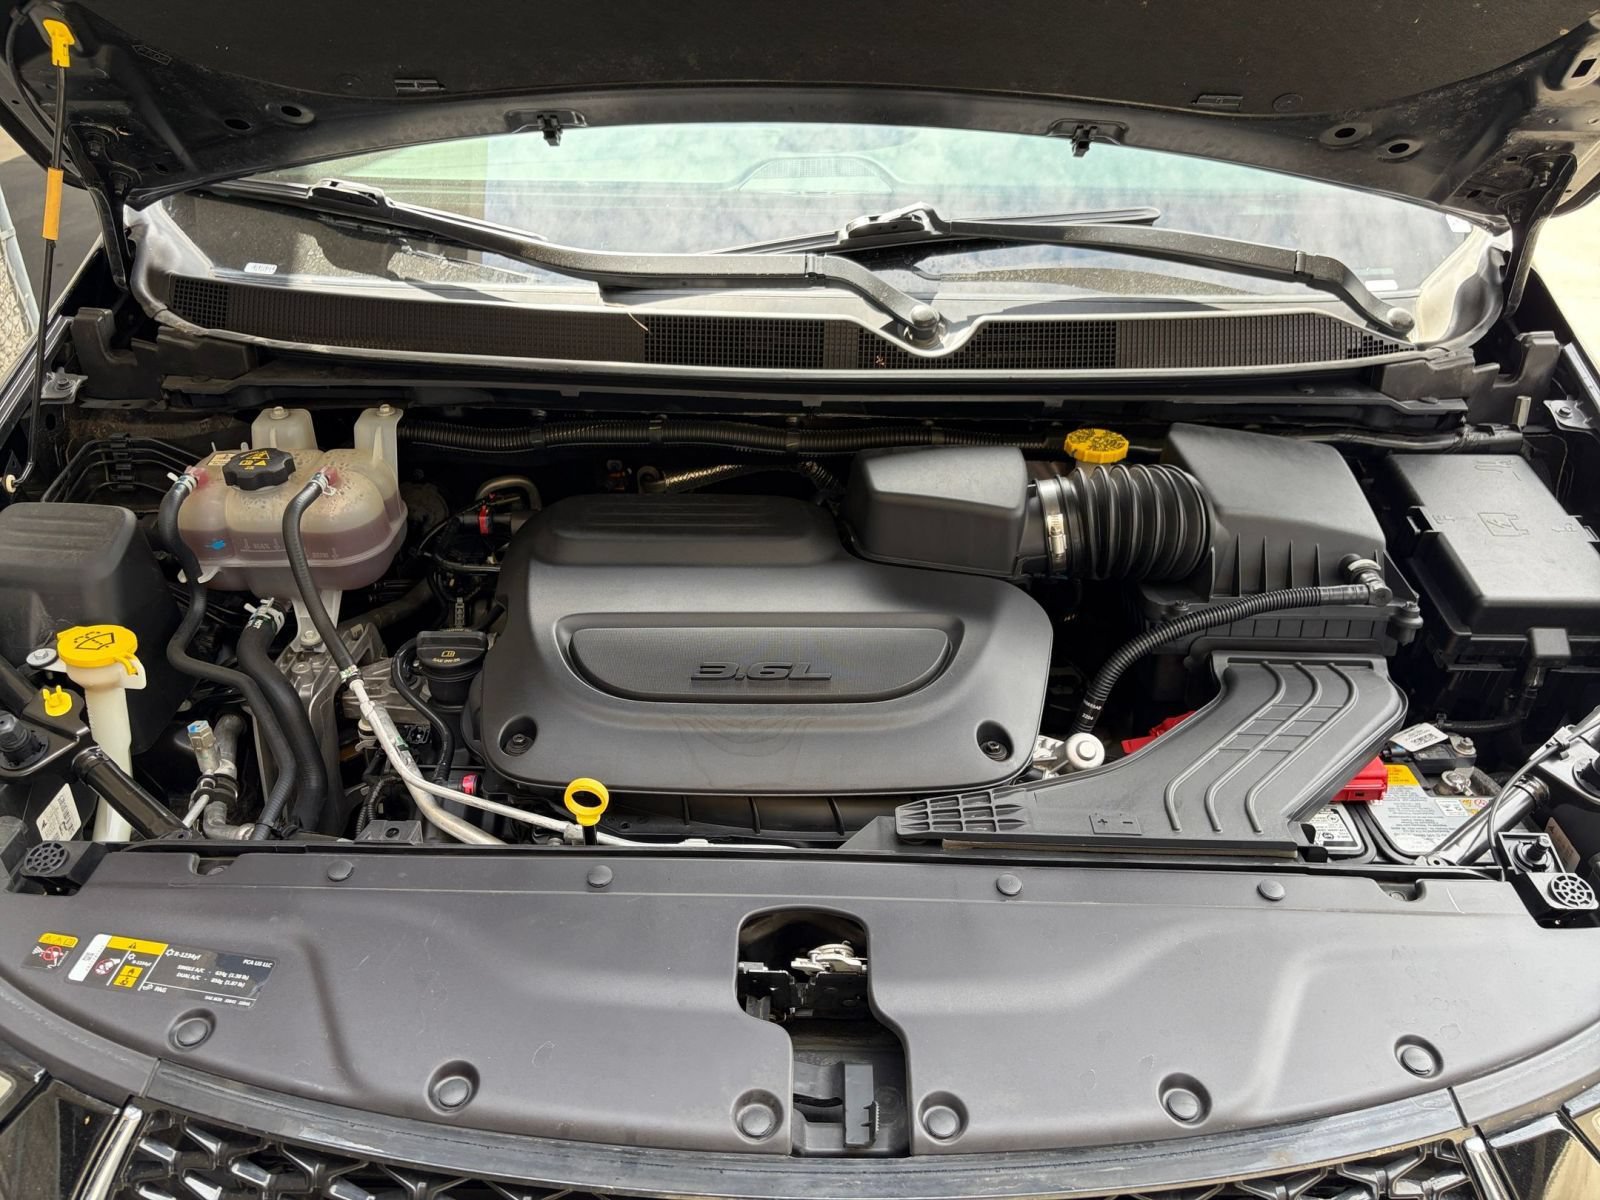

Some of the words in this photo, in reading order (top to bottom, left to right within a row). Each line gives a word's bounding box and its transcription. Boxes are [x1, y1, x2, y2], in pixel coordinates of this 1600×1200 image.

[691, 661, 832, 681] 3.6L
[174, 951, 201, 960] R-1234yf
[243, 958, 254, 966] FCA
[254, 959, 262, 967] US
[153, 985, 168, 993] PAG
